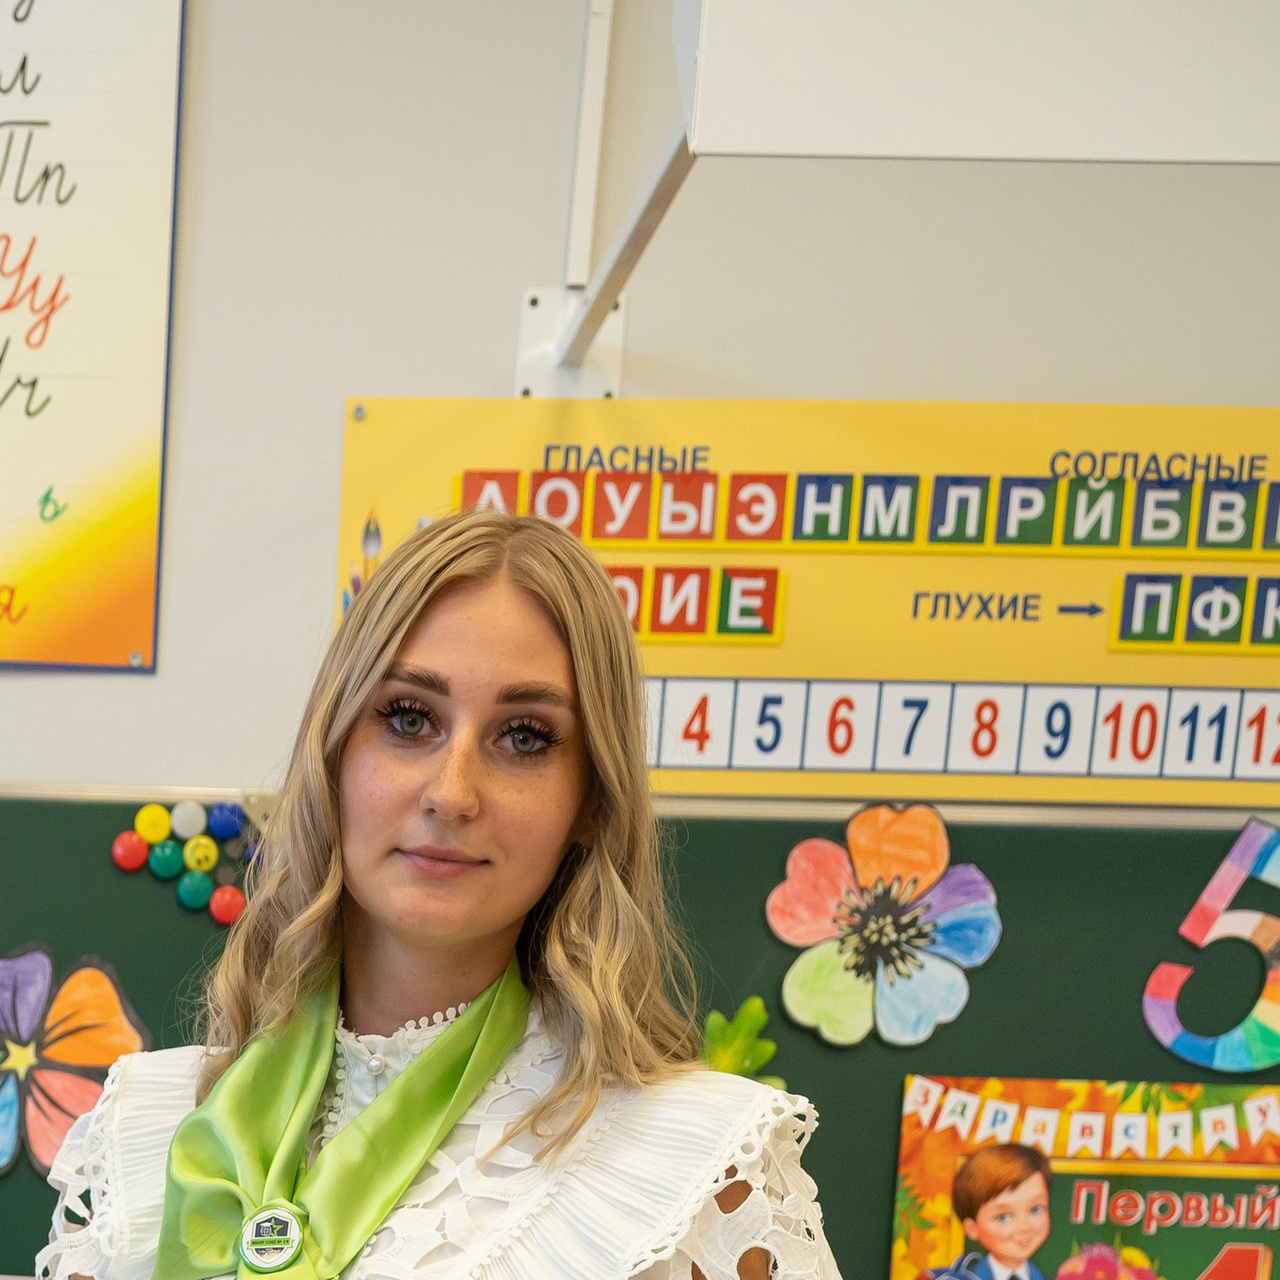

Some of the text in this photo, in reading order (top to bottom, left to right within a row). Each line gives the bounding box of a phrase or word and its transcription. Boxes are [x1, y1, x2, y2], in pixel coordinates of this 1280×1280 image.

[542, 444, 712, 474] ГЛАСНЫЕ
[1048, 450, 1269, 483] СОГЛАСНЫЕ
[38, 484, 68, 524] ь
[912, 592, 1042, 622] ГЛУХИЕ
[680, 692, 712, 754] 4
[754, 695, 784, 756] 5
[826, 695, 857, 757] 6
[901, 698, 930, 757] 7
[970, 698, 1000, 759] 8
[1043, 700, 1073, 761] 9
[1102, 699, 1159, 763] 10
[1179, 702, 1228, 764] 11
[1070, 1179, 1280, 1236] Первый
